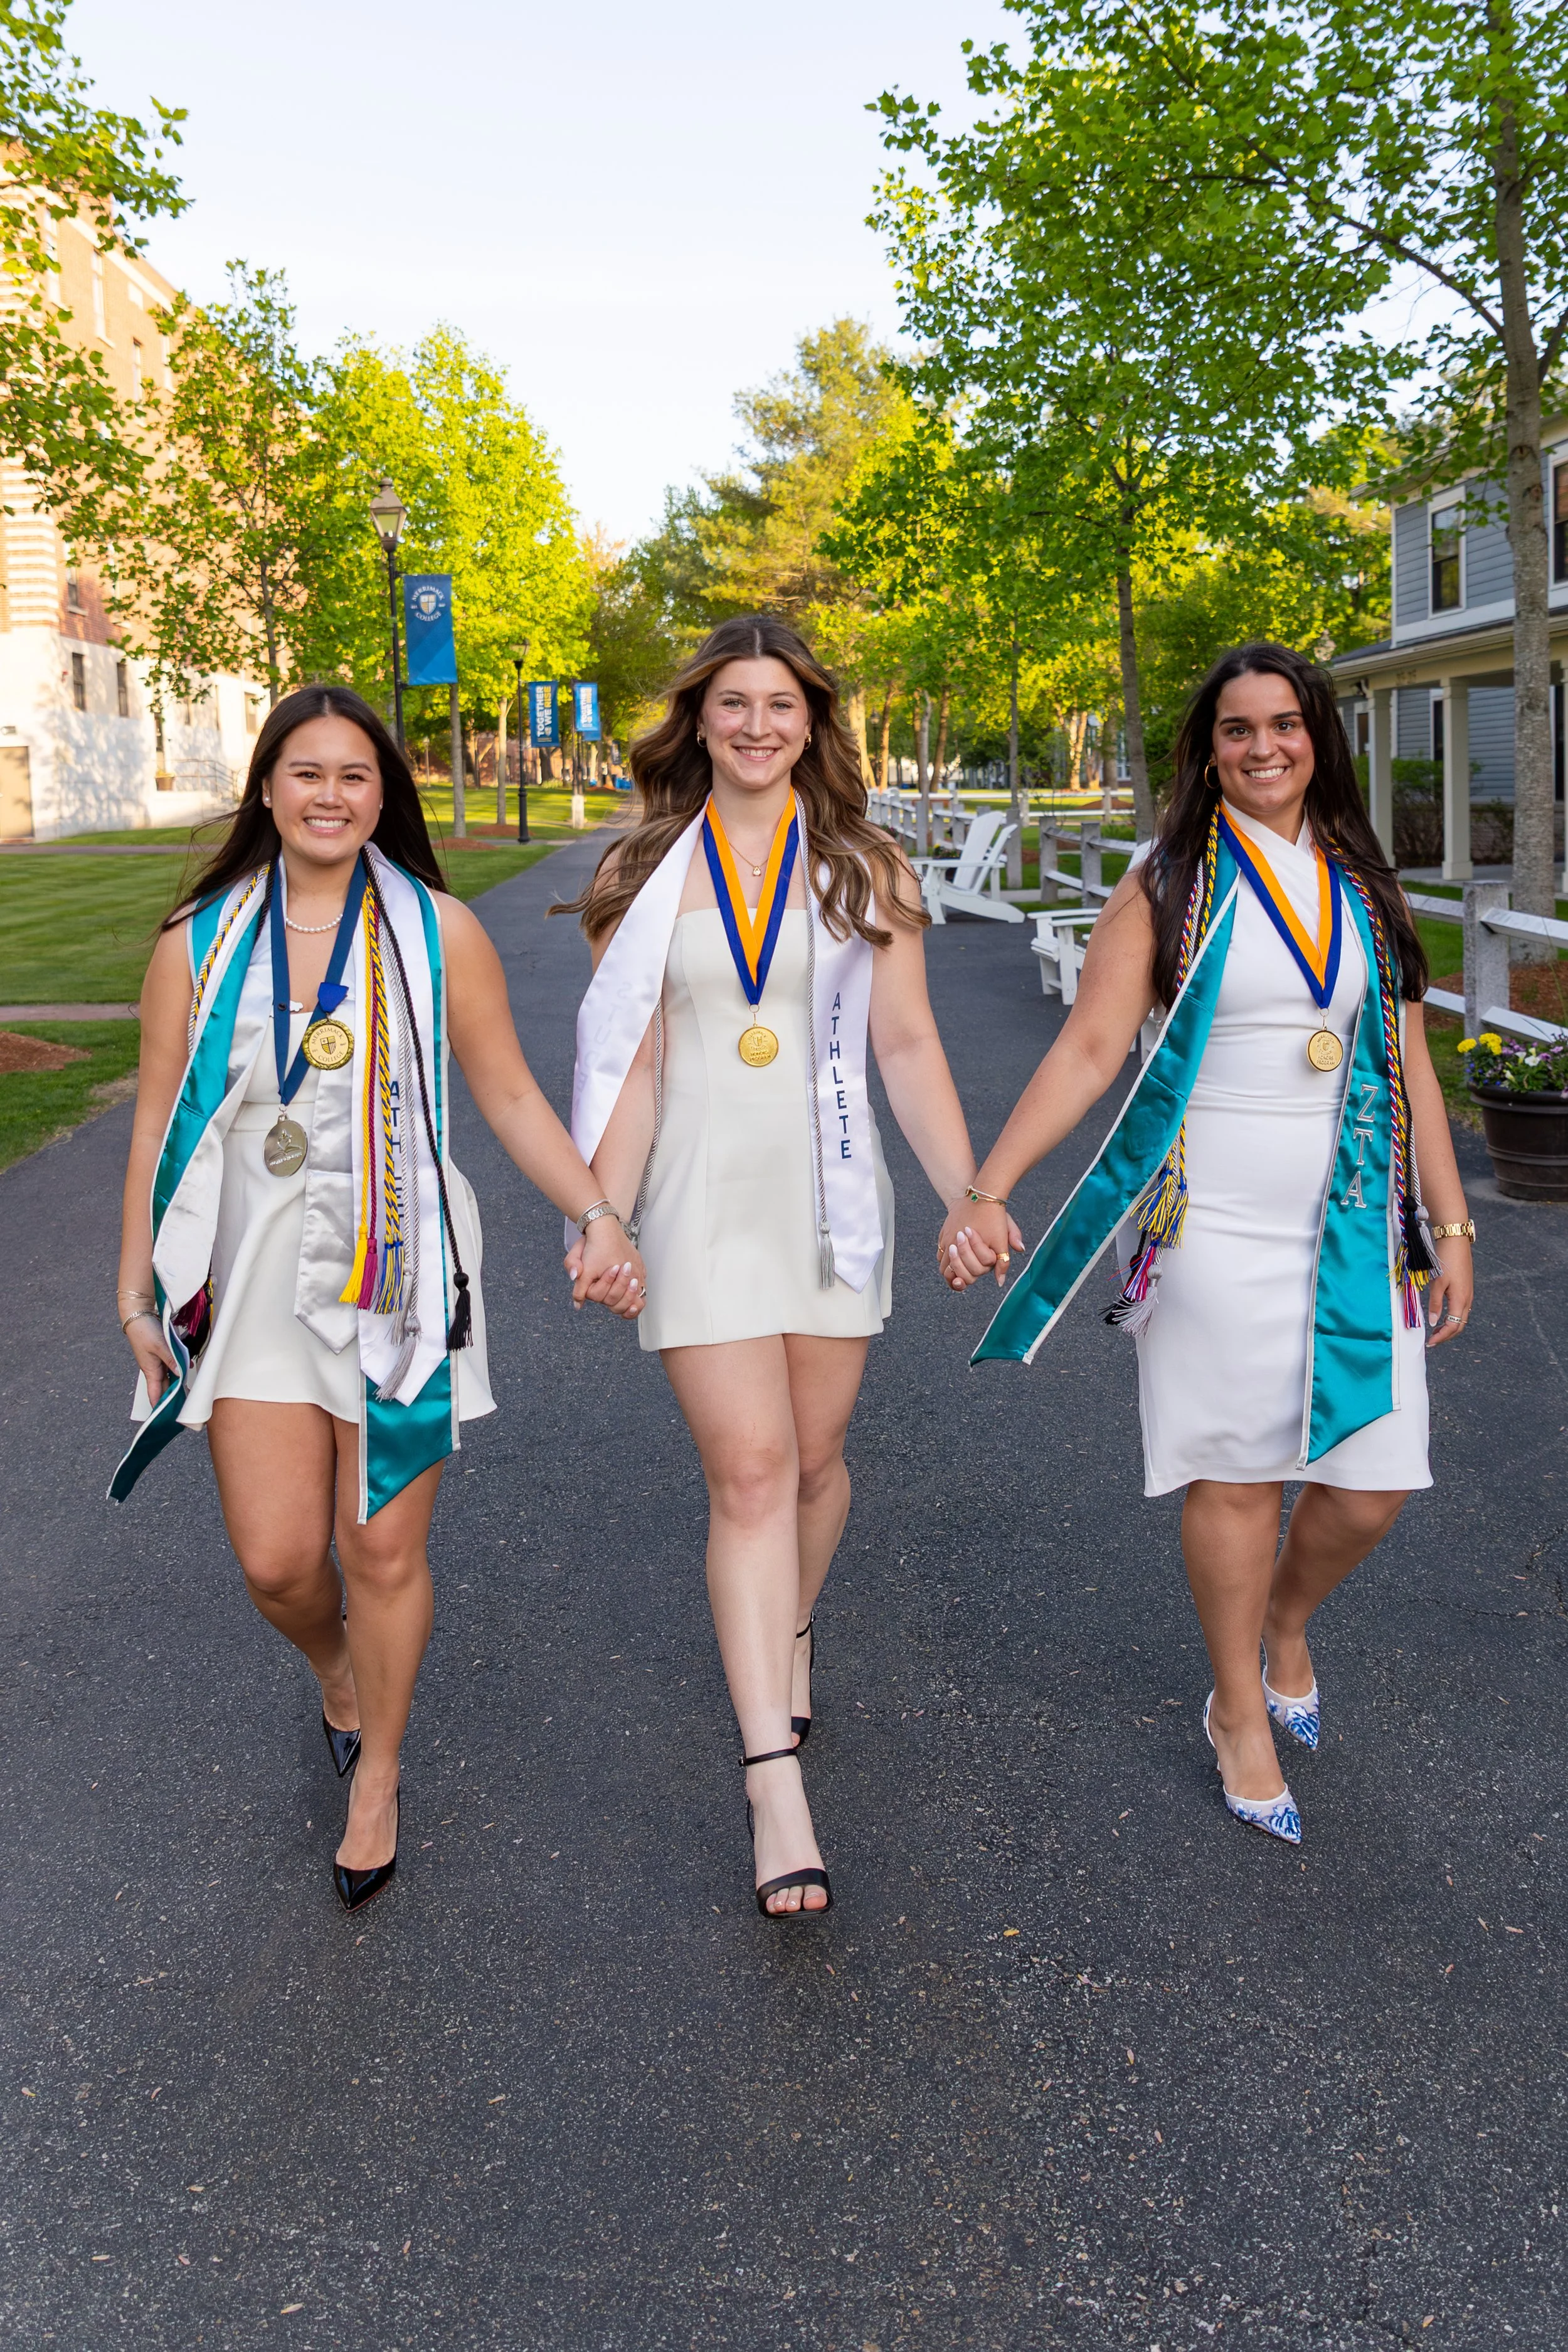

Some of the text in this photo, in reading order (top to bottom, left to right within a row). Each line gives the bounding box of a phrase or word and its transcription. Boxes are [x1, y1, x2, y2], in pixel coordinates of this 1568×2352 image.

[411, 586, 445, 602] MERRIMACK
[415, 611, 442, 622] COLLEGE
[536, 686, 544, 737] TOGETHER
[544, 709, 552, 726] WE
[311, 1027, 344, 1044] MERRIMACK
[318, 1051, 344, 1062] COLLEGE
[830, 992, 851, 1159] ATHLETE
[1340, 1084, 1379, 1208] ZTA
